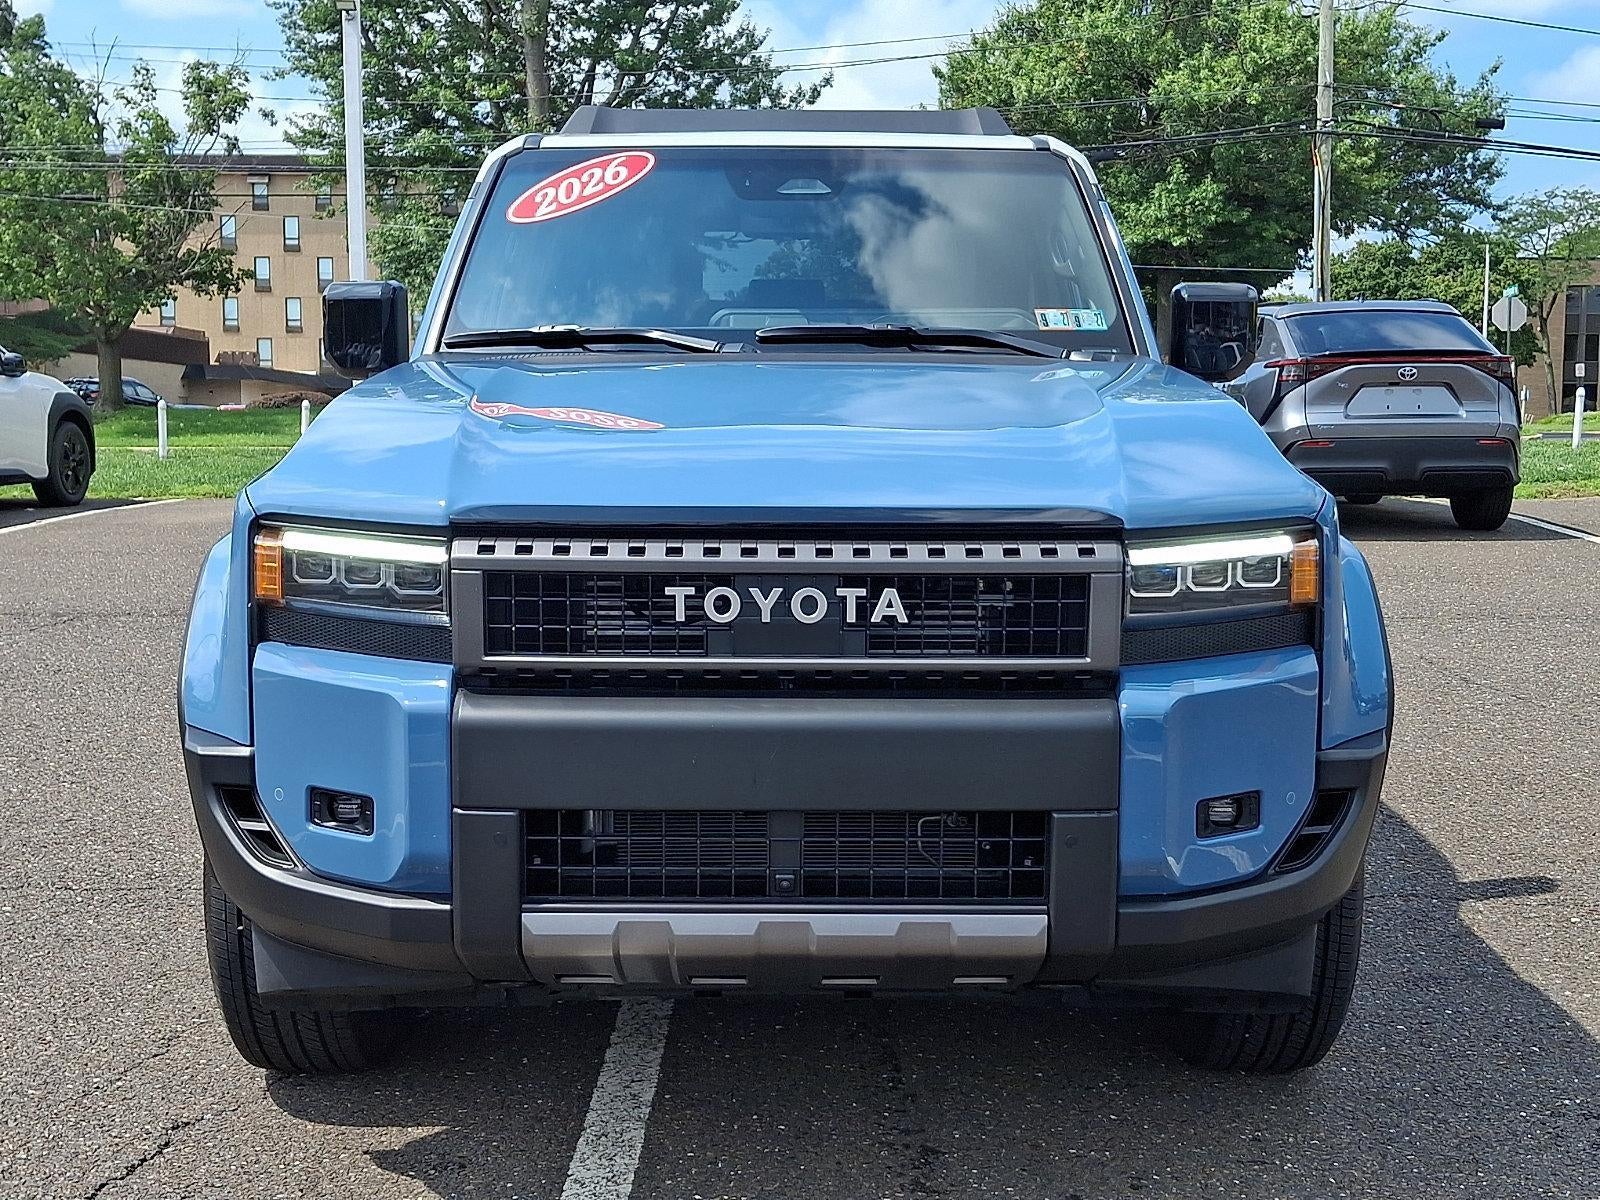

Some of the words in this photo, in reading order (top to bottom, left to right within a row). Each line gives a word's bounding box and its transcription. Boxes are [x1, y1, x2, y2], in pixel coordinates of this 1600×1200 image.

[534, 156, 629, 217] 2026
[1040, 312, 1049, 328] 9
[1074, 315, 1082, 328] 9
[664, 586, 909, 624] TOYOTA
